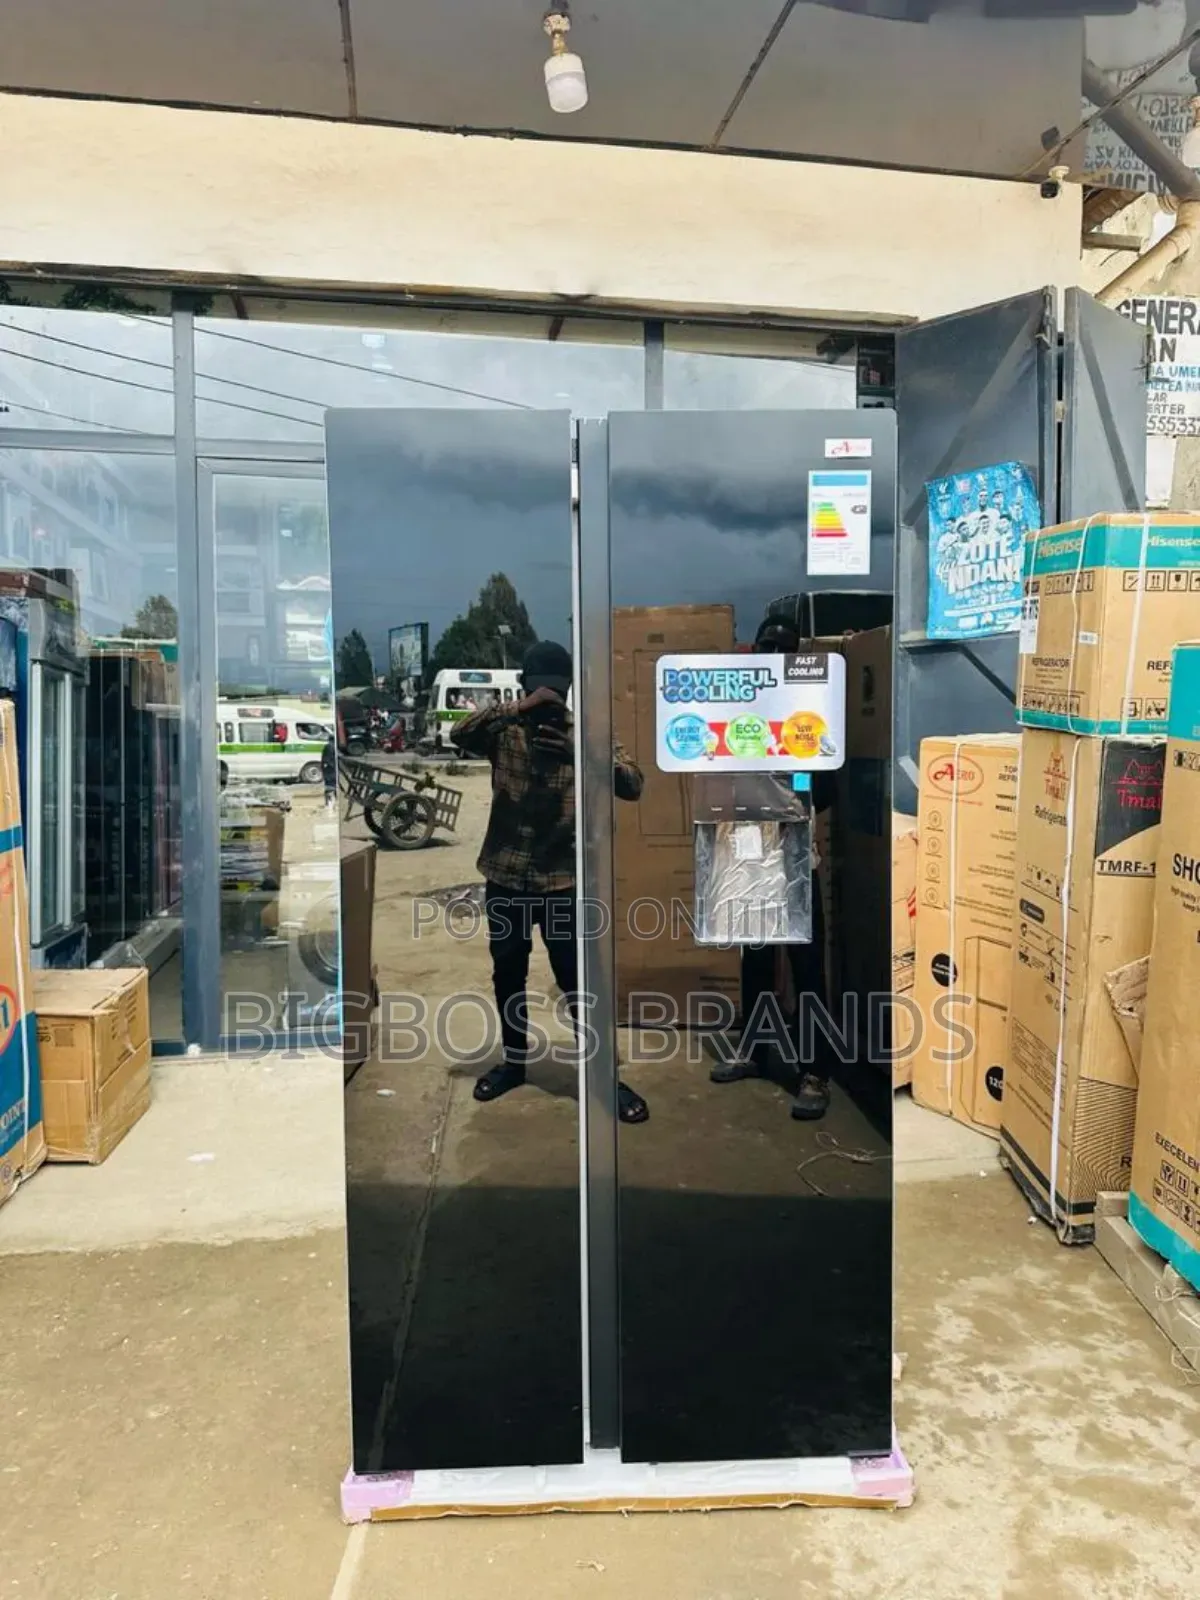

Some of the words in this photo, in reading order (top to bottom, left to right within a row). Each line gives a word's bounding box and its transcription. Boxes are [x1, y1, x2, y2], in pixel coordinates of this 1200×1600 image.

[1115, 298, 1200, 335] GENER
[1169, 365, 1200, 379] UME
[958, 539, 1012, 565] ZOTE
[795, 656, 817, 665] FAST
[1147, 660, 1173, 671] REF
[663, 668, 778, 688] POWERFUL
[788, 666, 825, 676] COOLING
[663, 684, 757, 702] COOLING
[735, 724, 761, 734] ECO
